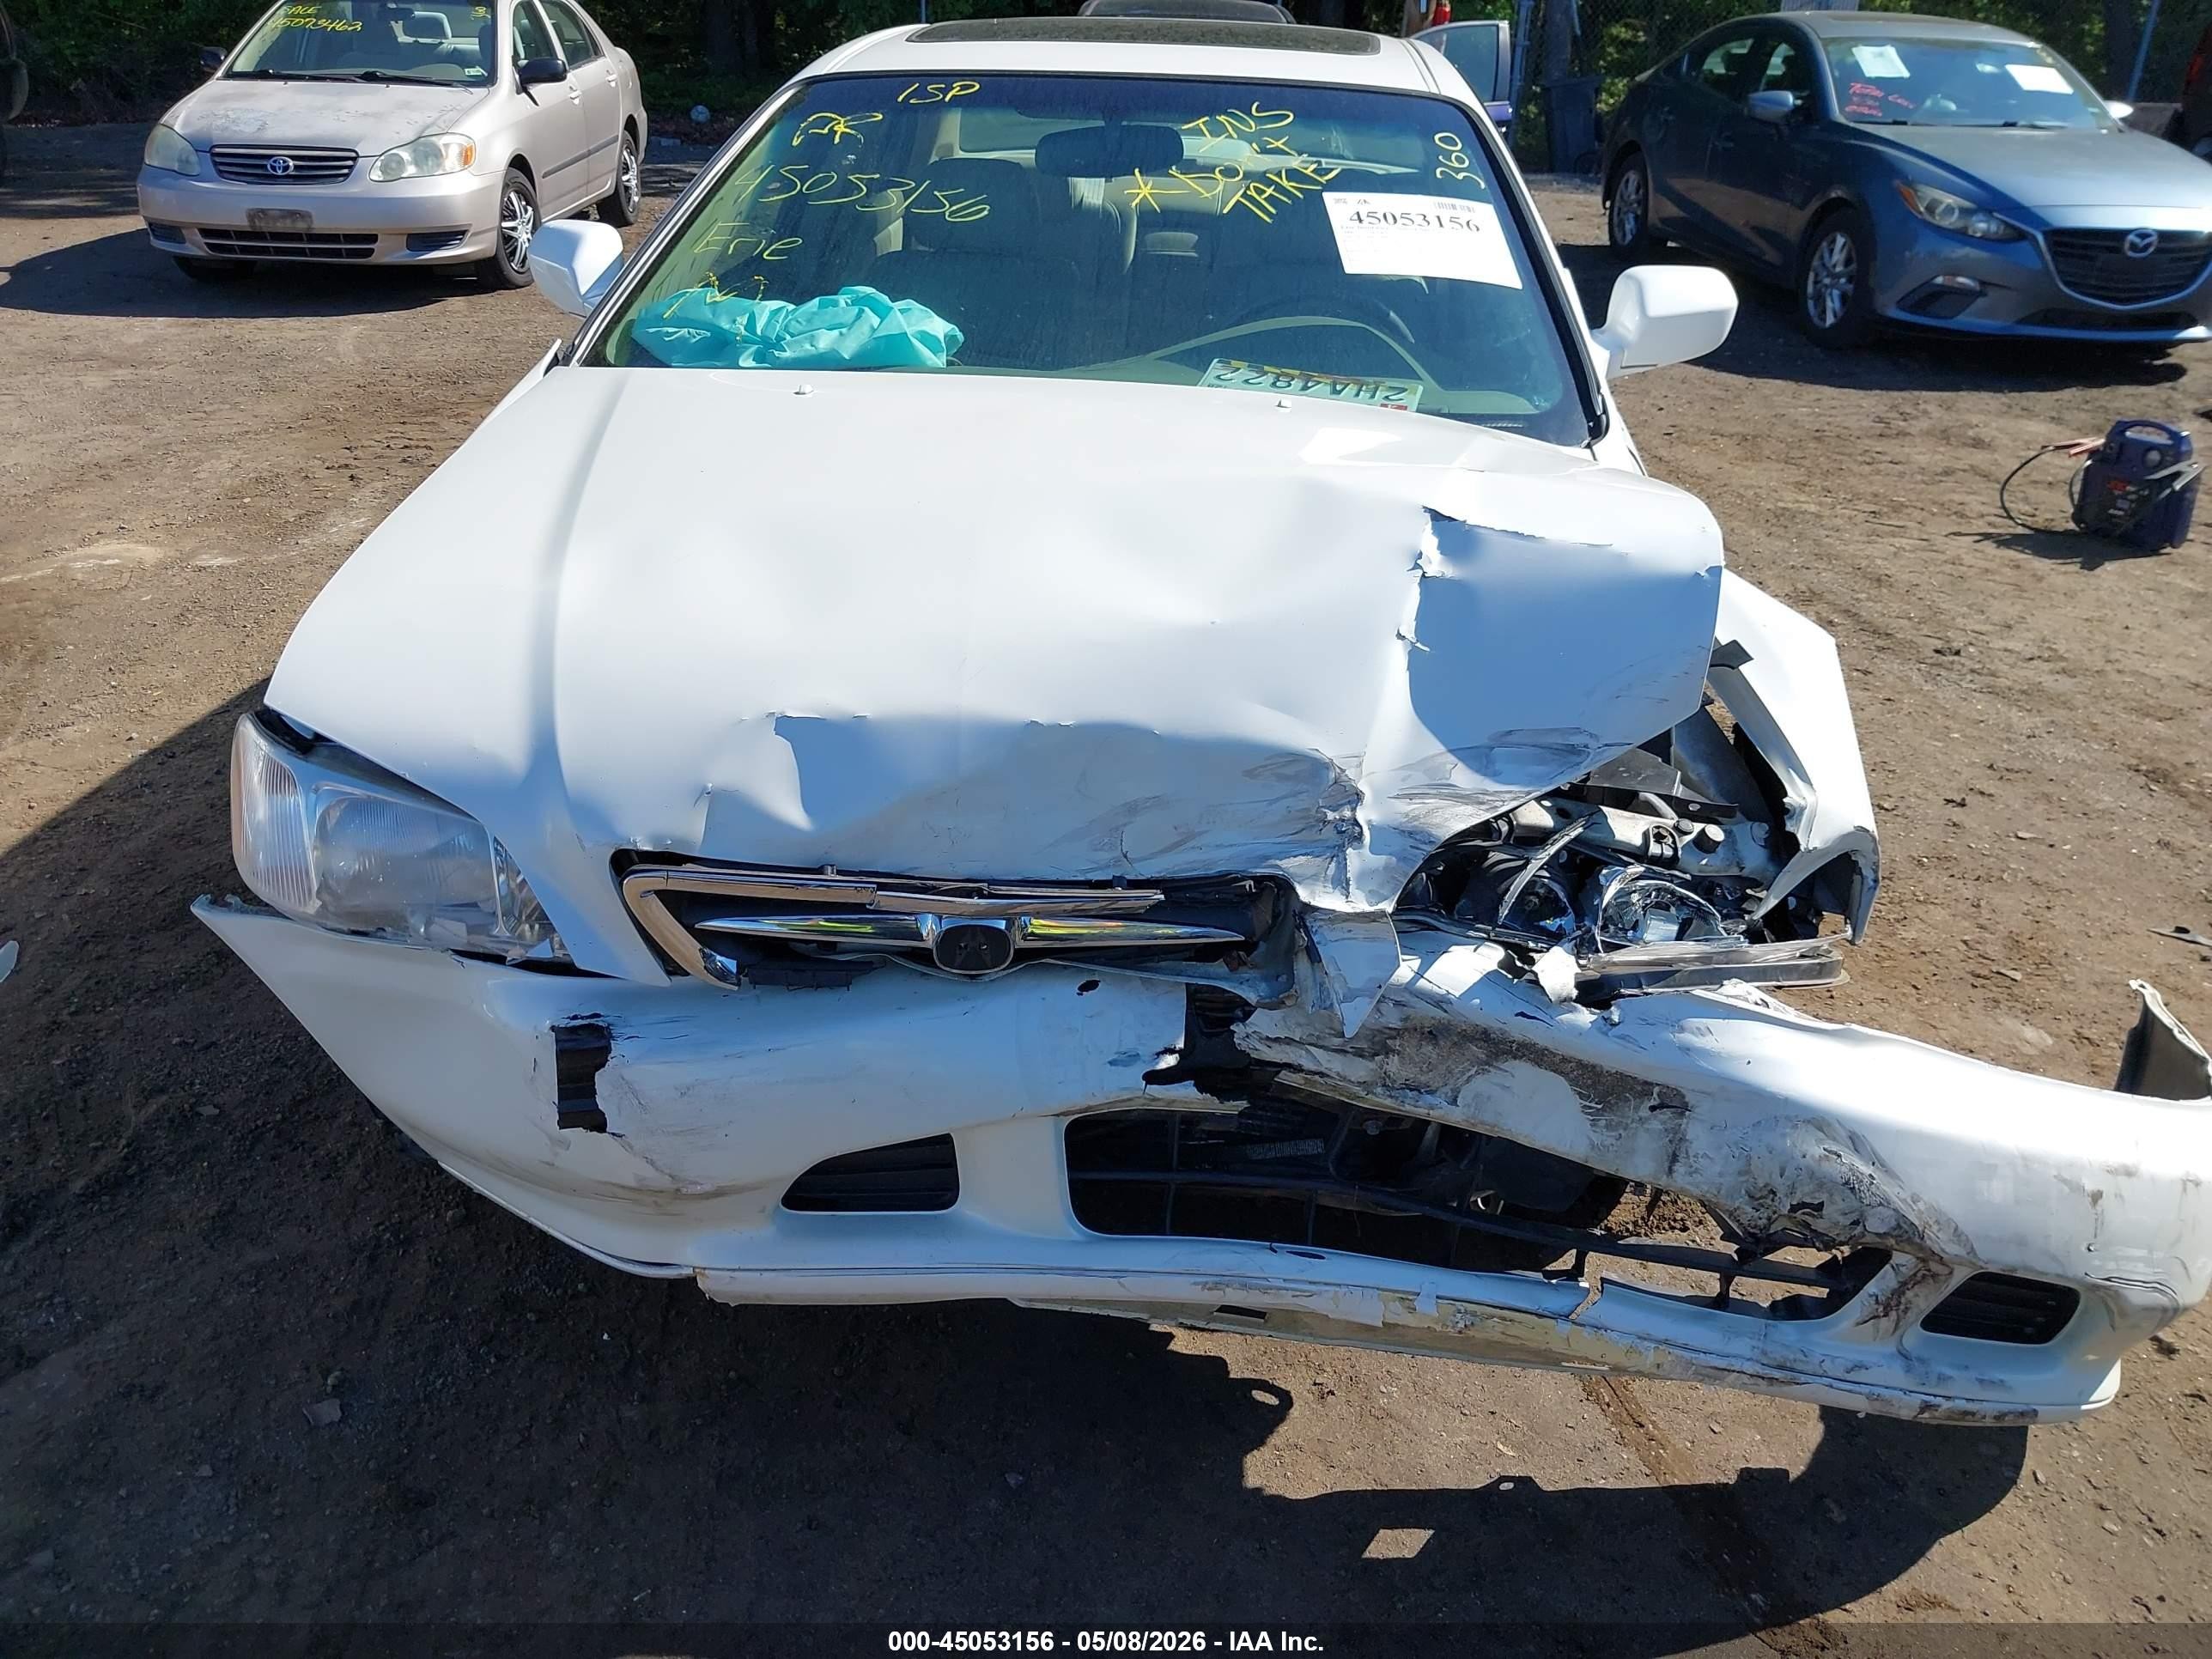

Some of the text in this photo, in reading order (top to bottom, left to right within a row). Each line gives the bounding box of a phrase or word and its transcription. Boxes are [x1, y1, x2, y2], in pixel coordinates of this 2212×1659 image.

[1223, 154, 1341, 224] TAKE
[1434, 132, 1486, 190] 360
[735, 161, 991, 222] 45053156
[694, 222, 804, 260] Erie
[1349, 210, 1480, 233] 45053156
